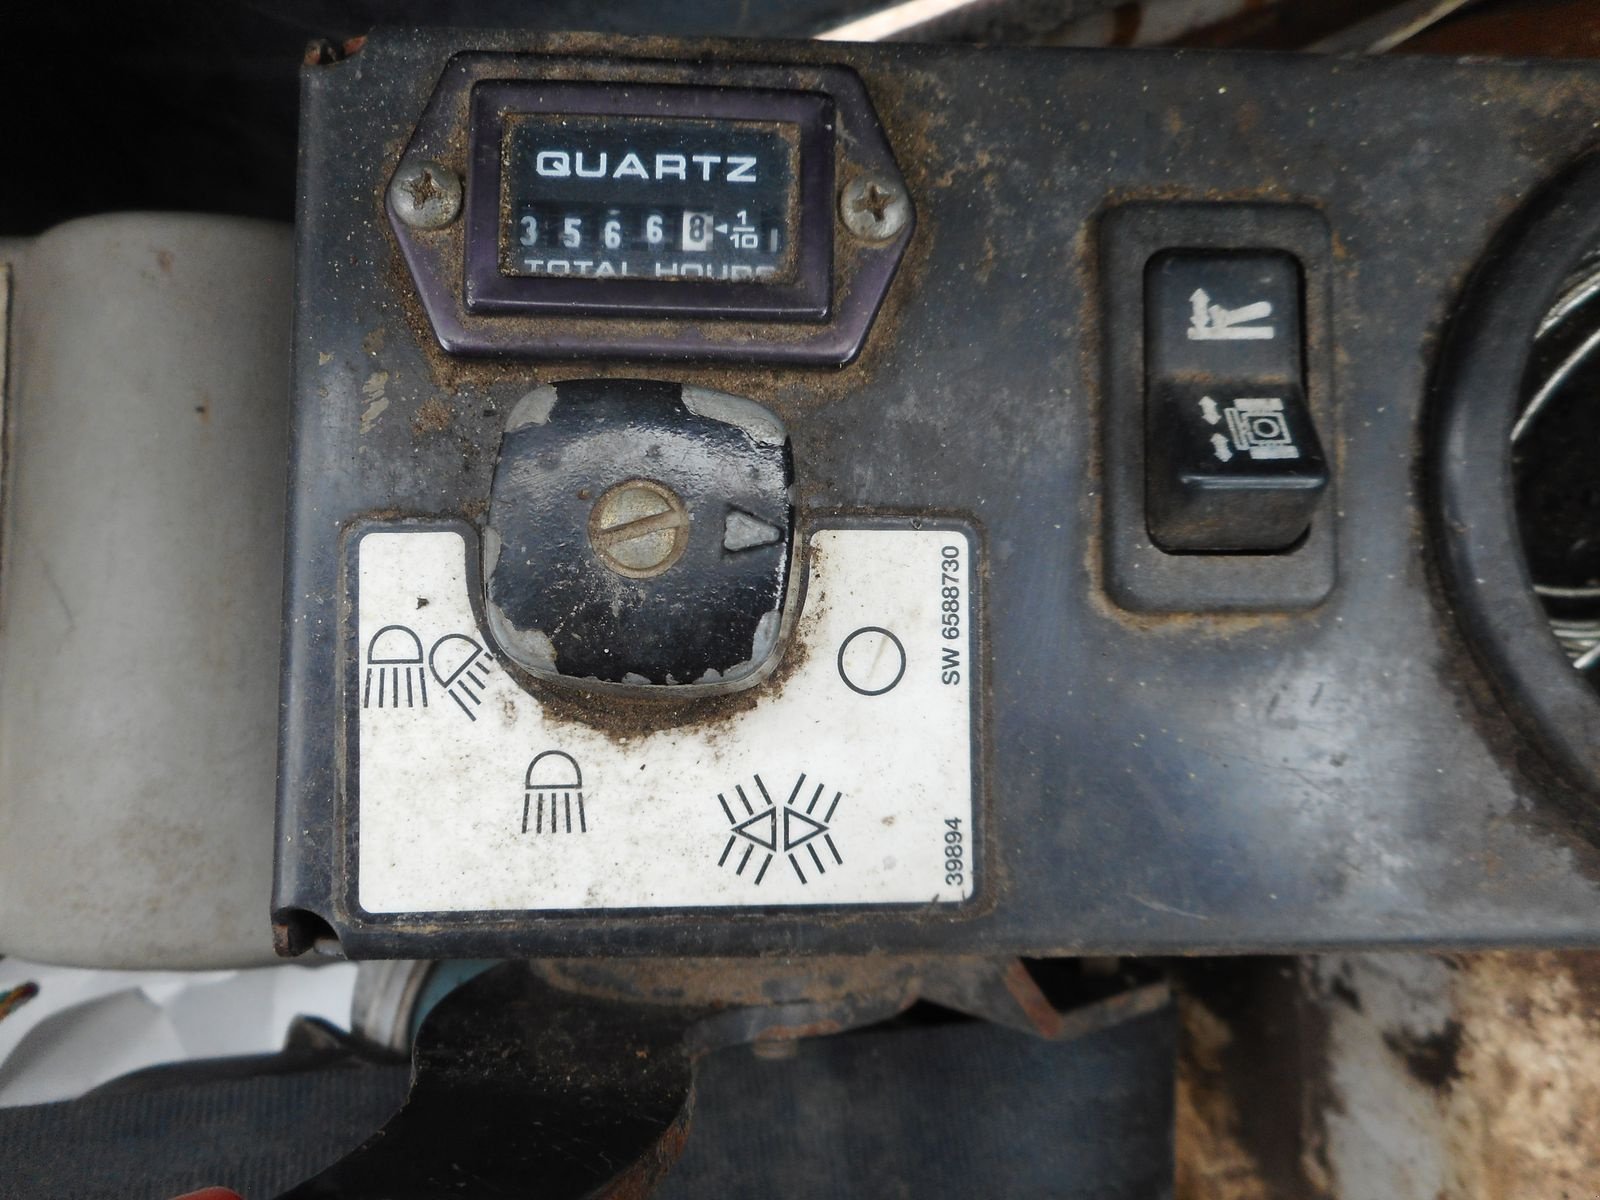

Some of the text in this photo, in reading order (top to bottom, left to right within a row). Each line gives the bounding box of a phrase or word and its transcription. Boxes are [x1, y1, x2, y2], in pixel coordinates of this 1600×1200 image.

[536, 151, 757, 183] QUARTZ
[941, 545, 960, 686] SW 6588730
[944, 817, 963, 886] 39894
